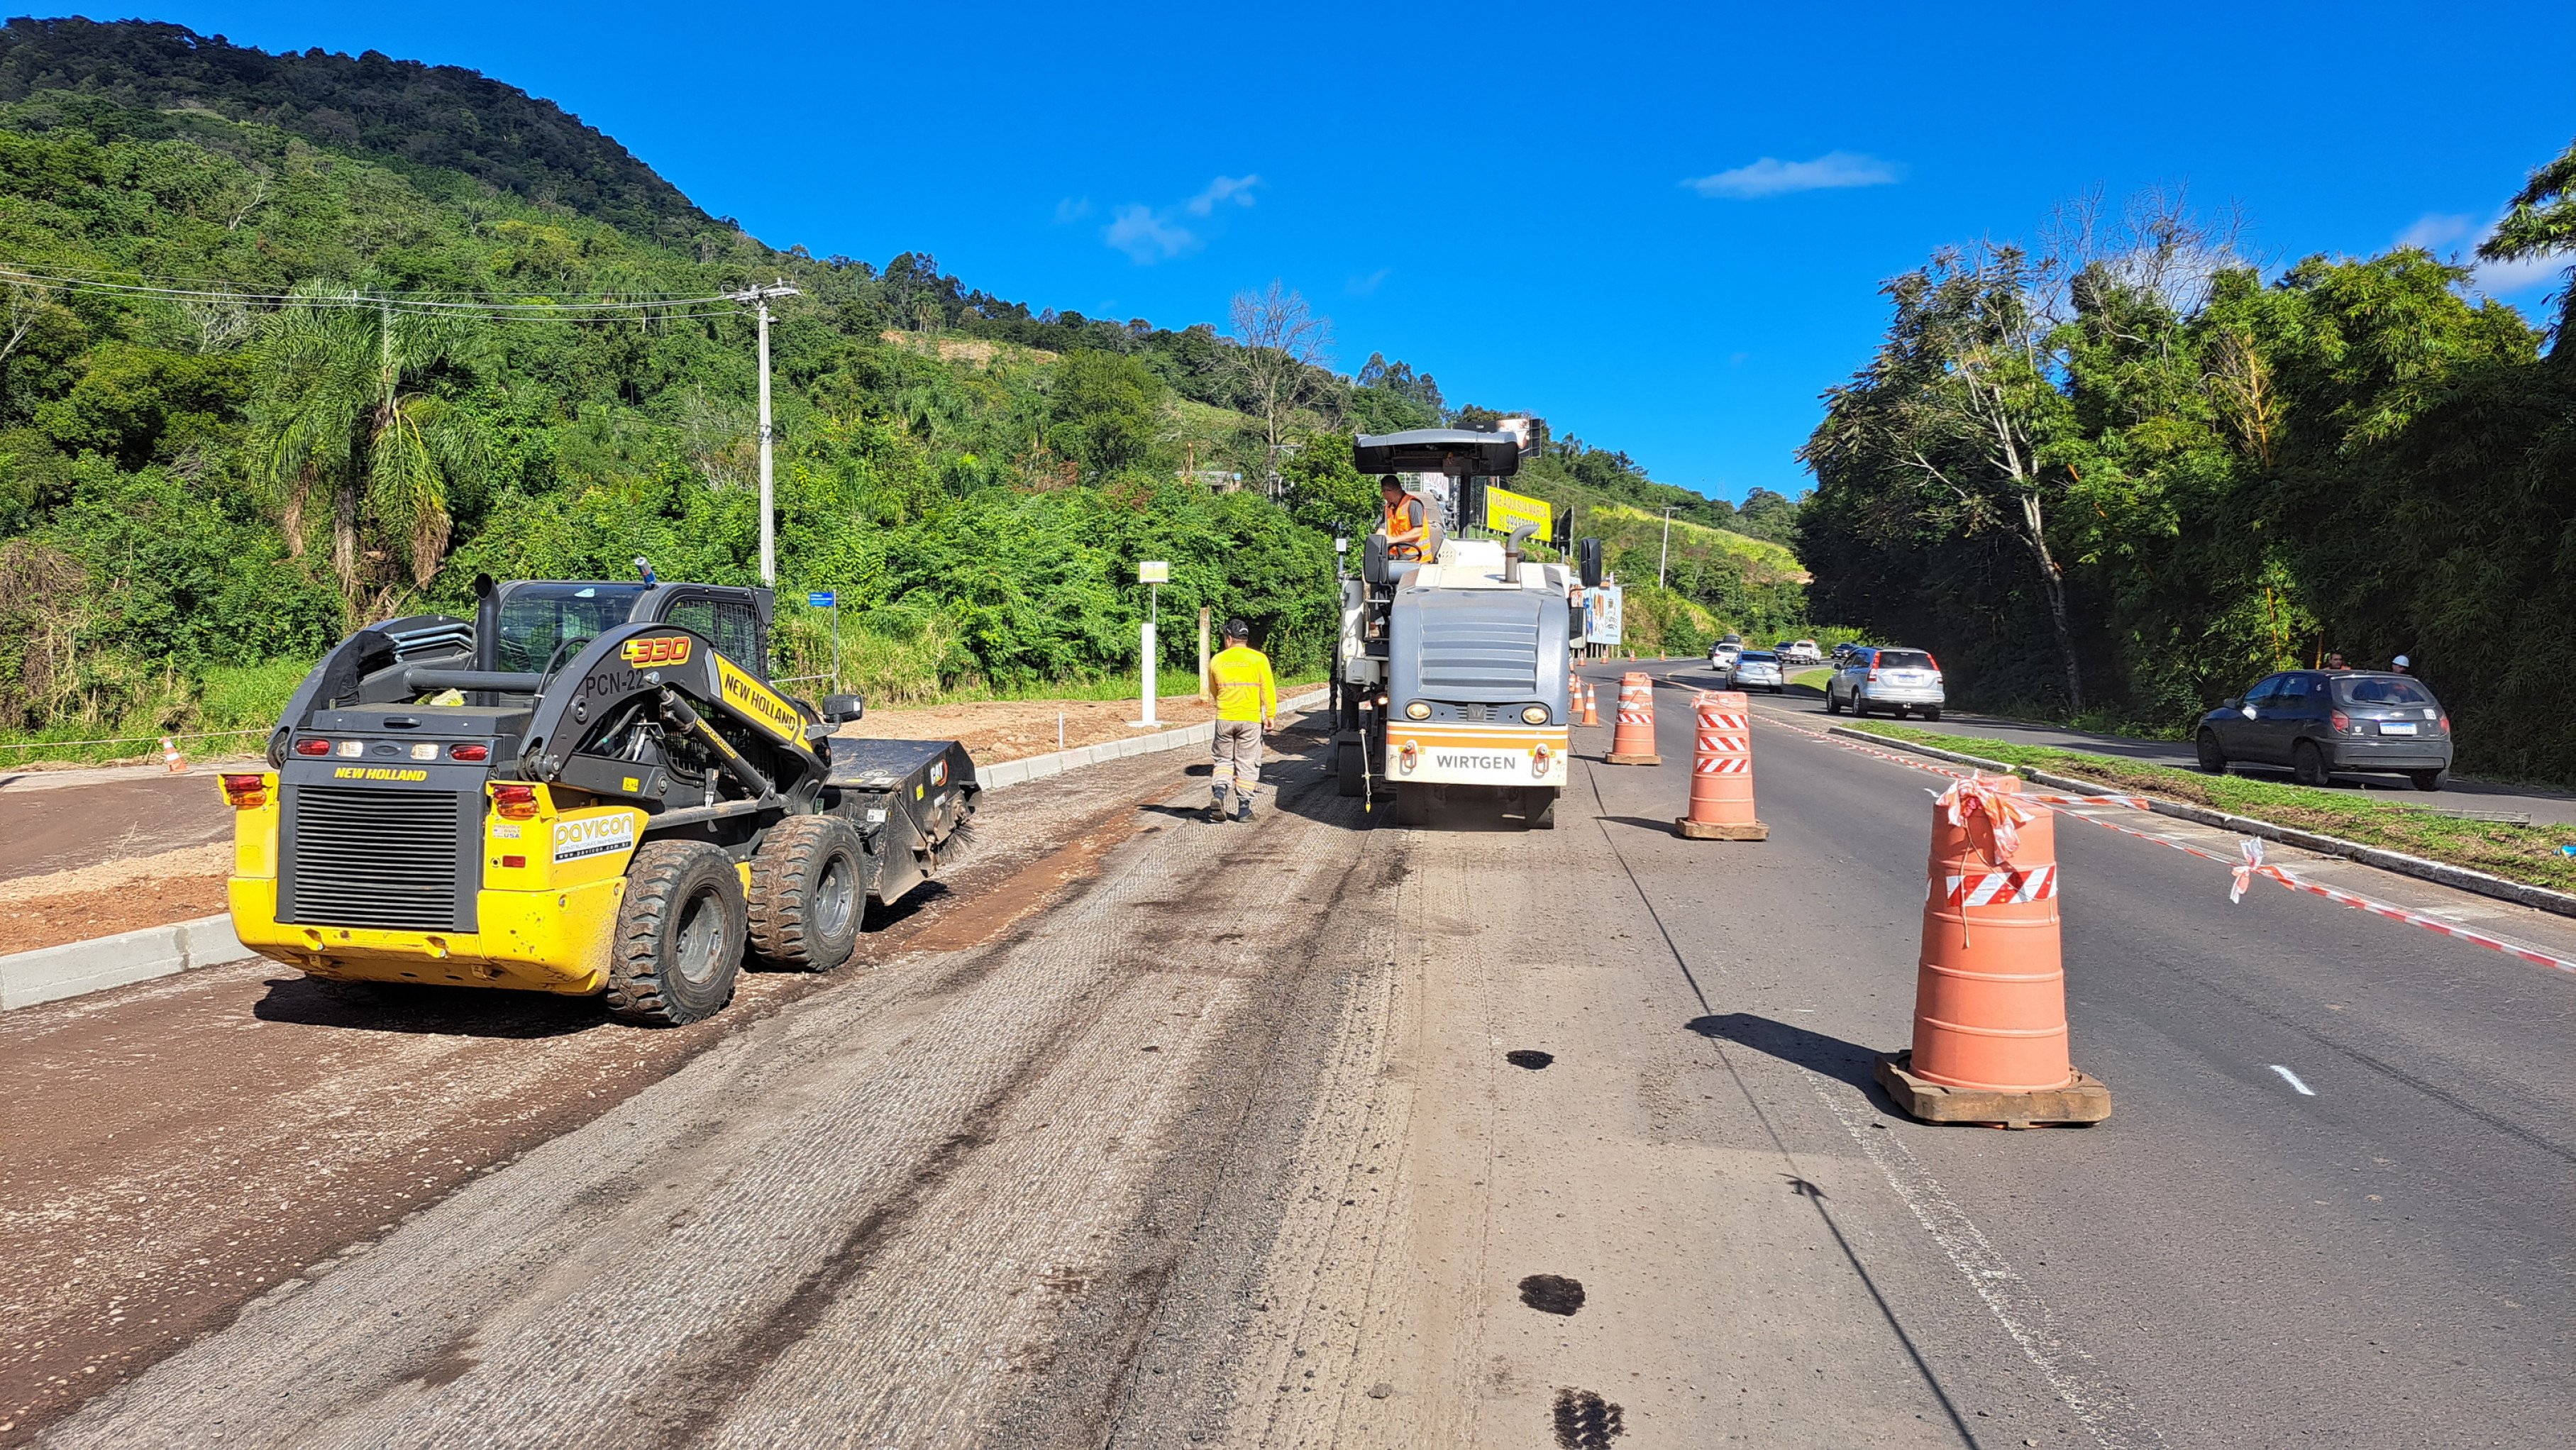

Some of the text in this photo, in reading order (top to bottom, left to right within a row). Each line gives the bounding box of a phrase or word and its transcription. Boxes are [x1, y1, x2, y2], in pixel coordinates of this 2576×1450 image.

[622, 638, 690, 665] L330
[586, 668, 644, 699] PCN-22
[724, 673, 796, 731] NEW HOLLAND
[334, 767, 427, 781] NEW HOLLAND
[1437, 755, 1516, 770] WIRTGEN
[555, 816, 632, 853] pavicon
[558, 842, 629, 859] www.pavicon.com.br
